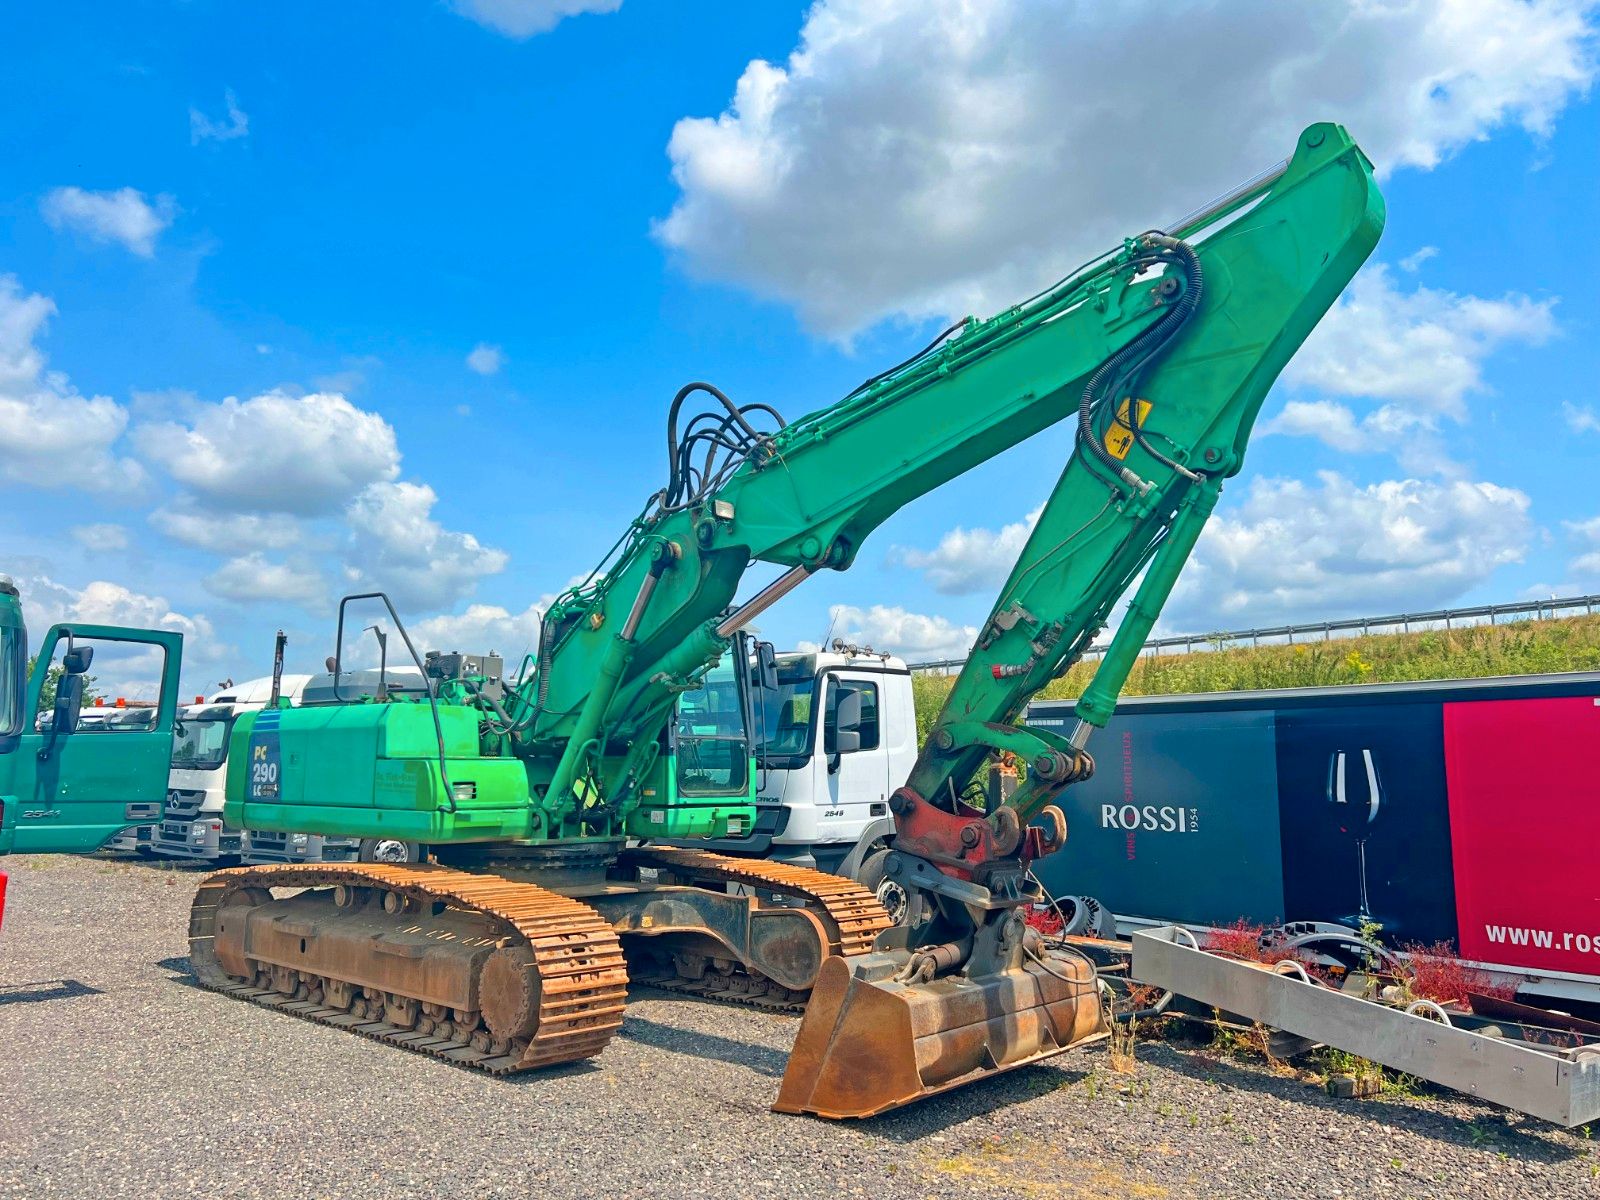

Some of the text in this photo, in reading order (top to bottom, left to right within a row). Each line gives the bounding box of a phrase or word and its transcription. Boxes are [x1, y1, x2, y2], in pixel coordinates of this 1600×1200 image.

[254, 746, 267, 760] PC
[253, 763, 277, 782] 290
[1123, 732, 1133, 802] SPIRITUEUX
[253, 784, 261, 796] LC
[1102, 804, 1186, 832] ROSSI
[1189, 808, 1199, 833] 1954
[1127, 833, 1136, 860] VINS
